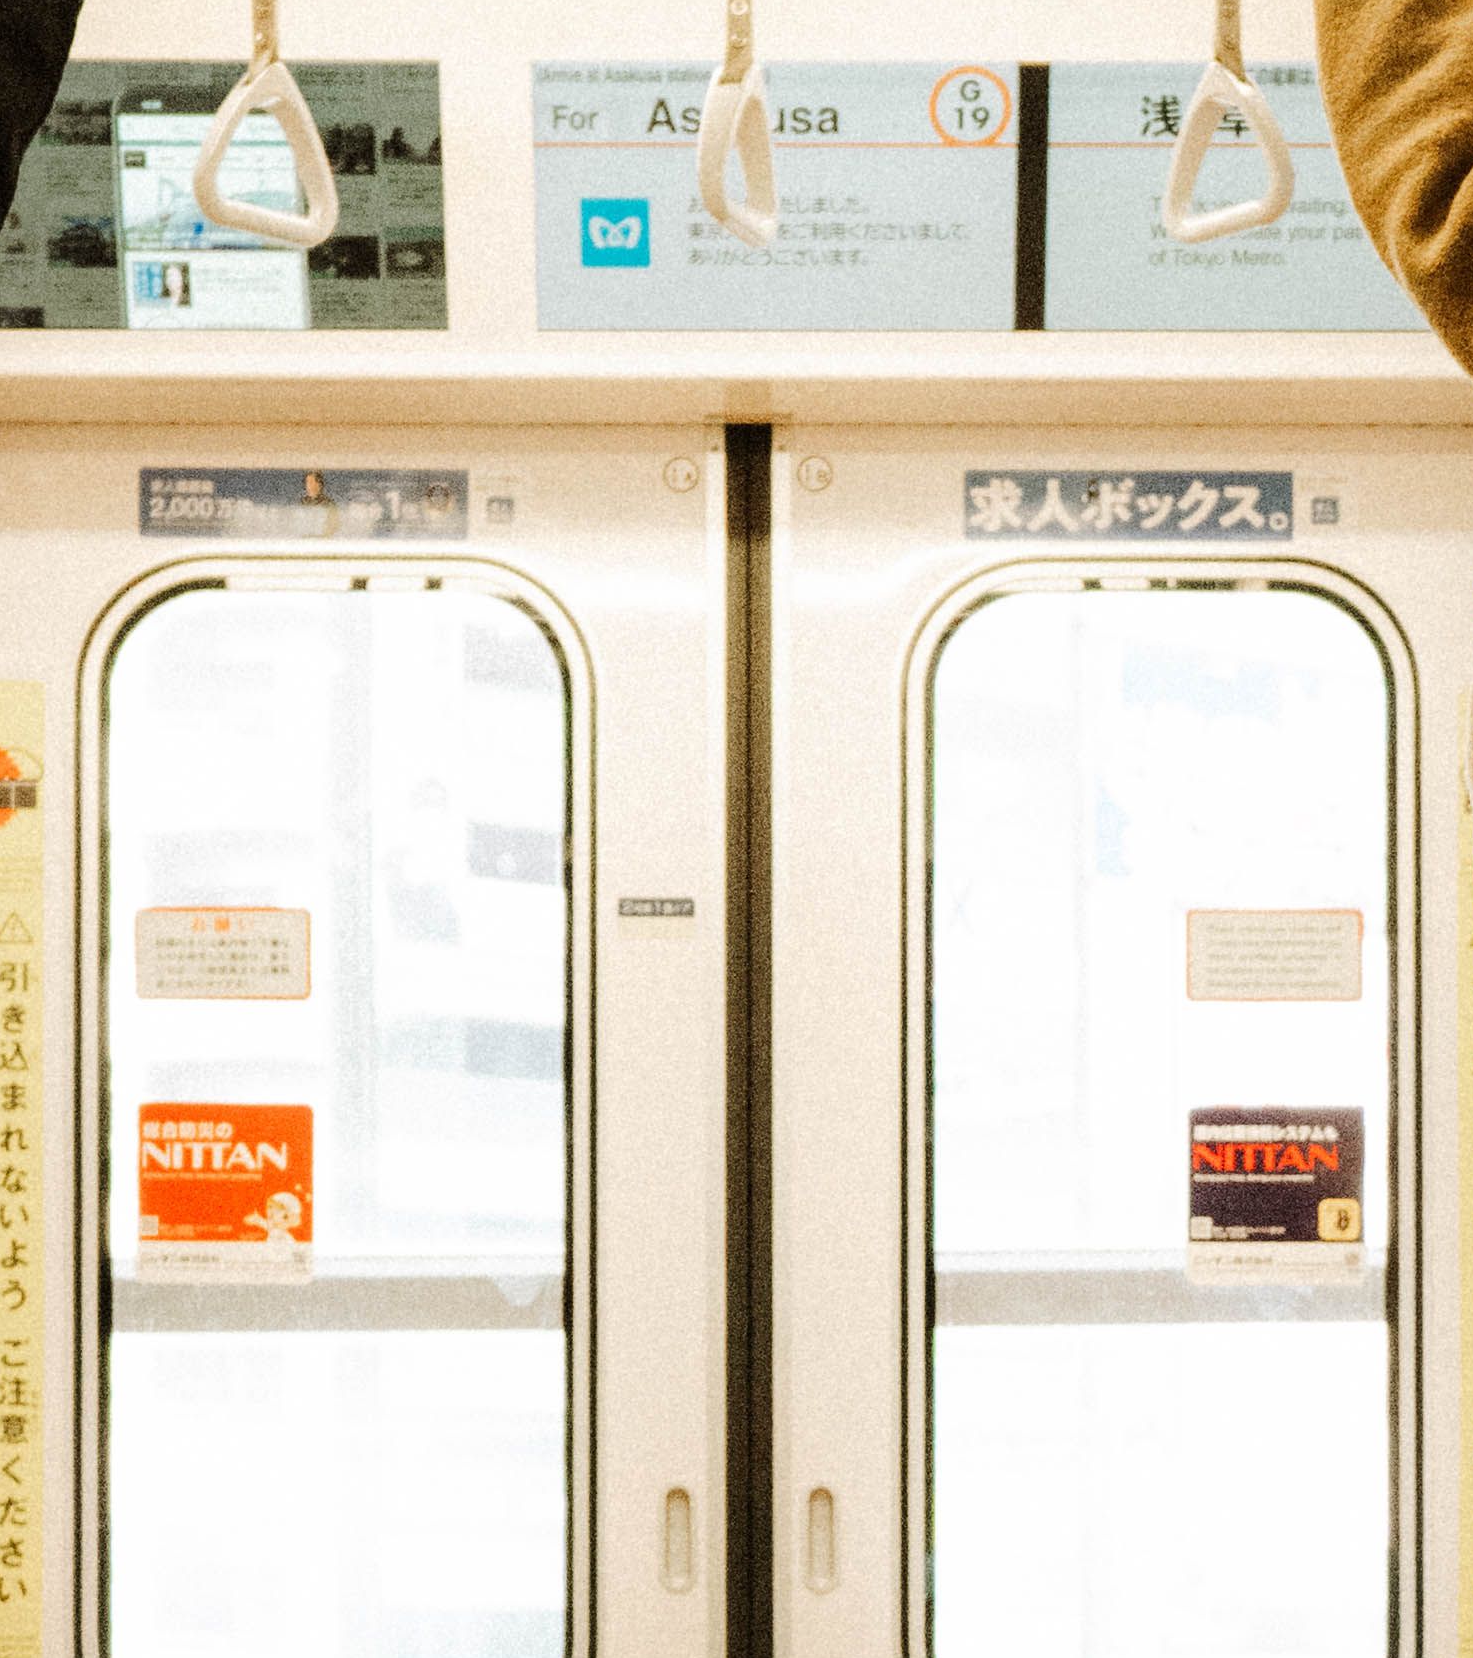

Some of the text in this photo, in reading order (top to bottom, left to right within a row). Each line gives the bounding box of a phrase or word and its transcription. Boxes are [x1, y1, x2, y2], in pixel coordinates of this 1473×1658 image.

[960, 79, 981, 102] G
[552, 98, 839, 134] For Assa
[954, 107, 989, 130] 19
[141, 1141, 289, 1172] NITTAN
[1191, 1142, 1341, 1173] NITTAN
